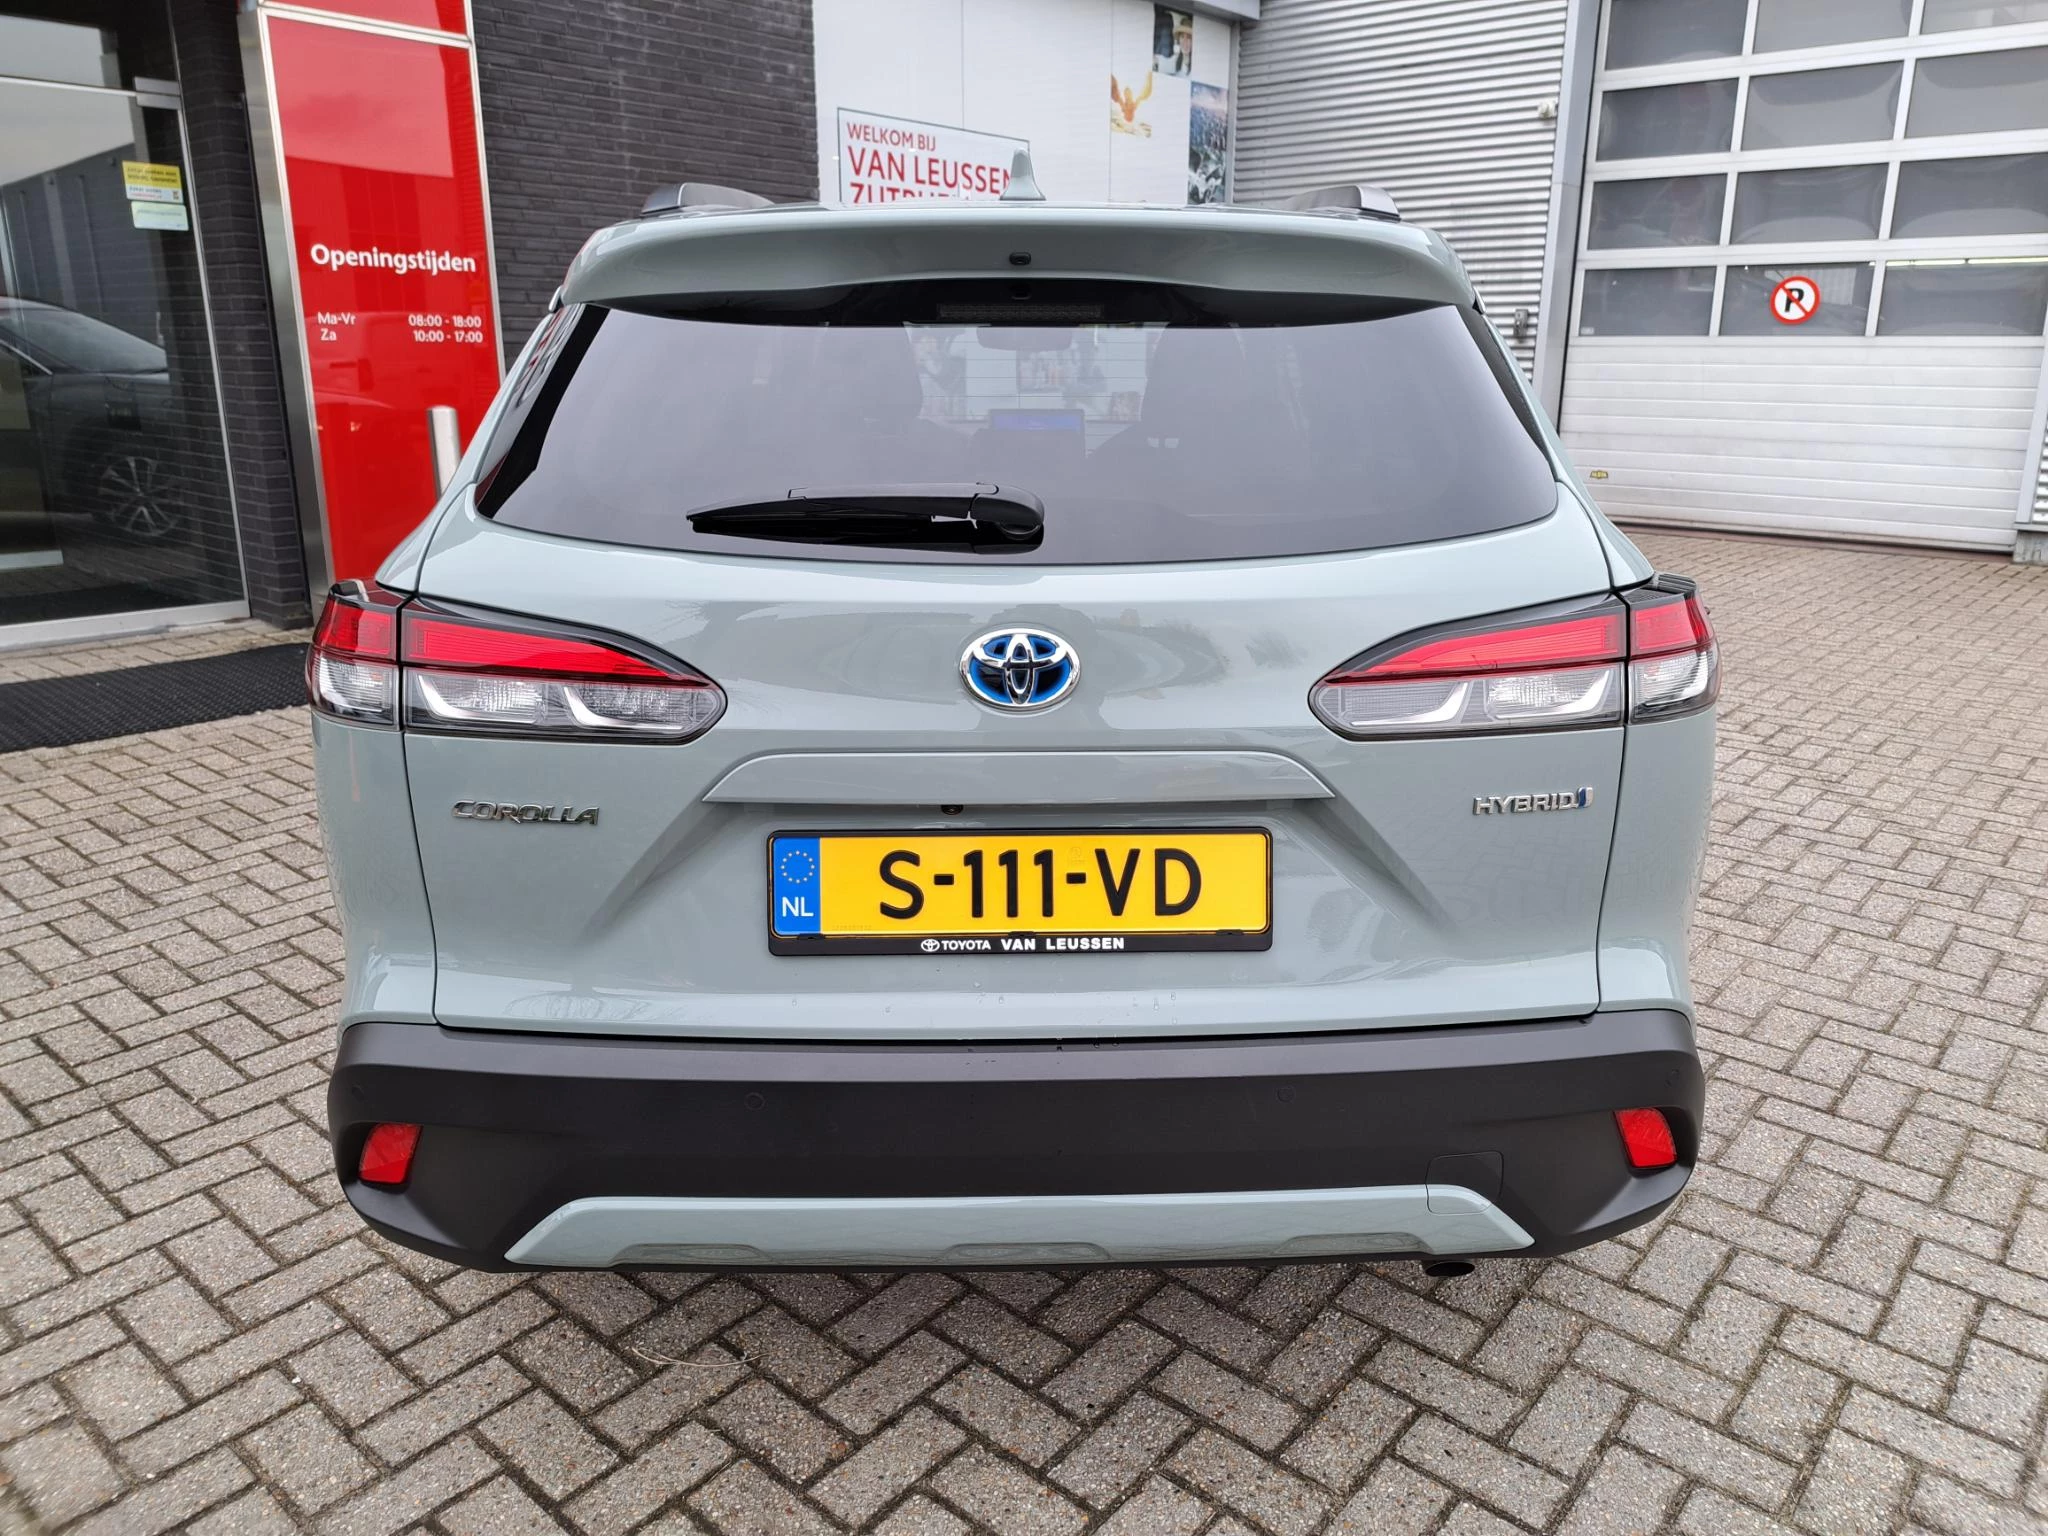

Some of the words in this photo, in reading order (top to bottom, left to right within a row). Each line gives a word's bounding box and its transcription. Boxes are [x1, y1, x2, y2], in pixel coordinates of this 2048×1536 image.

[847, 122, 914, 148] WELKOM
[917, 134, 936, 152] BIJ
[848, 145, 905, 182] VAN
[310, 243, 477, 276] Openingstijden
[317, 312, 356, 326] Ma-Vr
[408, 314, 442, 327] 08:00
[452, 315, 482, 328] 18:00
[320, 328, 337, 341] Za
[413, 330, 444, 343] 10:00
[454, 330, 483, 343] 17:00
[452, 800, 600, 825] COROLLA
[1473, 791, 1579, 815] HYBRID
[878, 848, 1202, 919] S-111-VD
[782, 896, 814, 917] NL
[941, 939, 991, 951] TOYOTA
[1001, 938, 1036, 951] VAN
[1046, 938, 1125, 950] LEUSSEN
